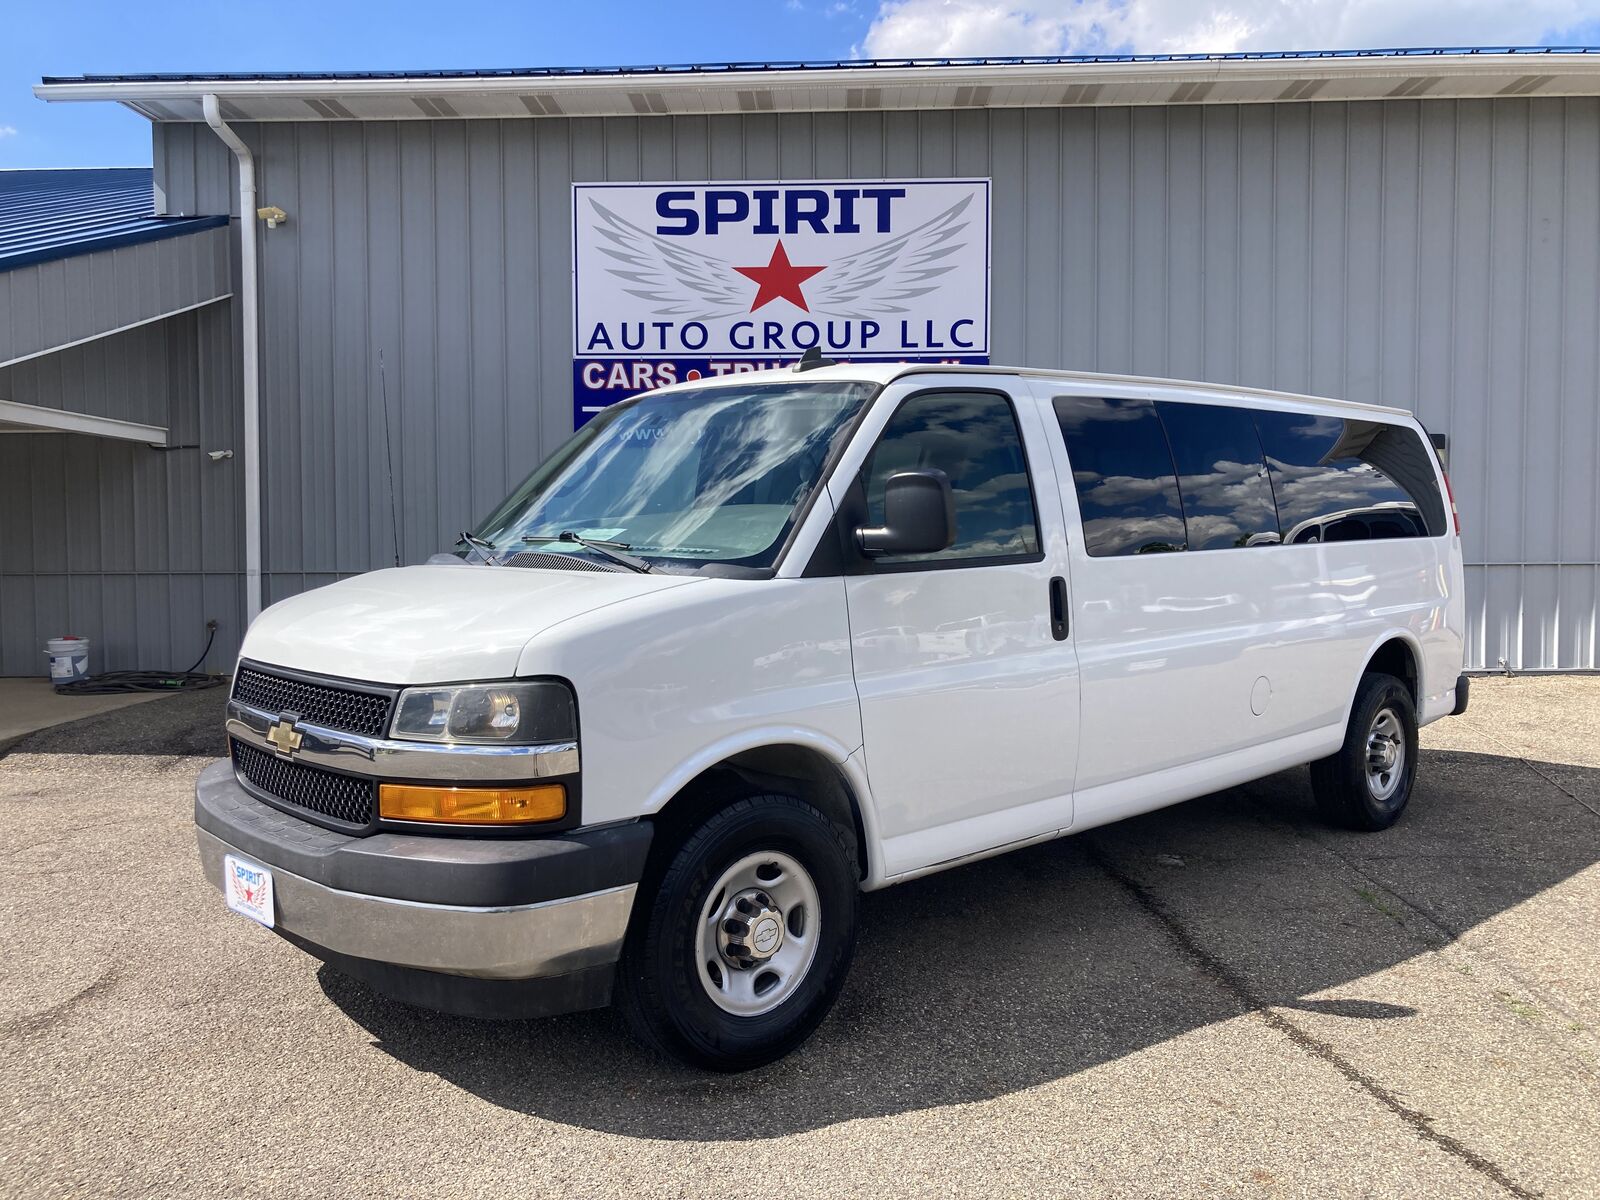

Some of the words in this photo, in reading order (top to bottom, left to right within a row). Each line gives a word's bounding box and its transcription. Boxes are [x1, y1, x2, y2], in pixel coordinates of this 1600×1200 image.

[655, 188, 906, 236] SPIRIT
[586, 321, 709, 351] AUTO
[729, 319, 881, 350] GROUP
[900, 318, 975, 349] LLC
[582, 361, 677, 390] CARS
[236, 866, 263, 886] SPIRIT
